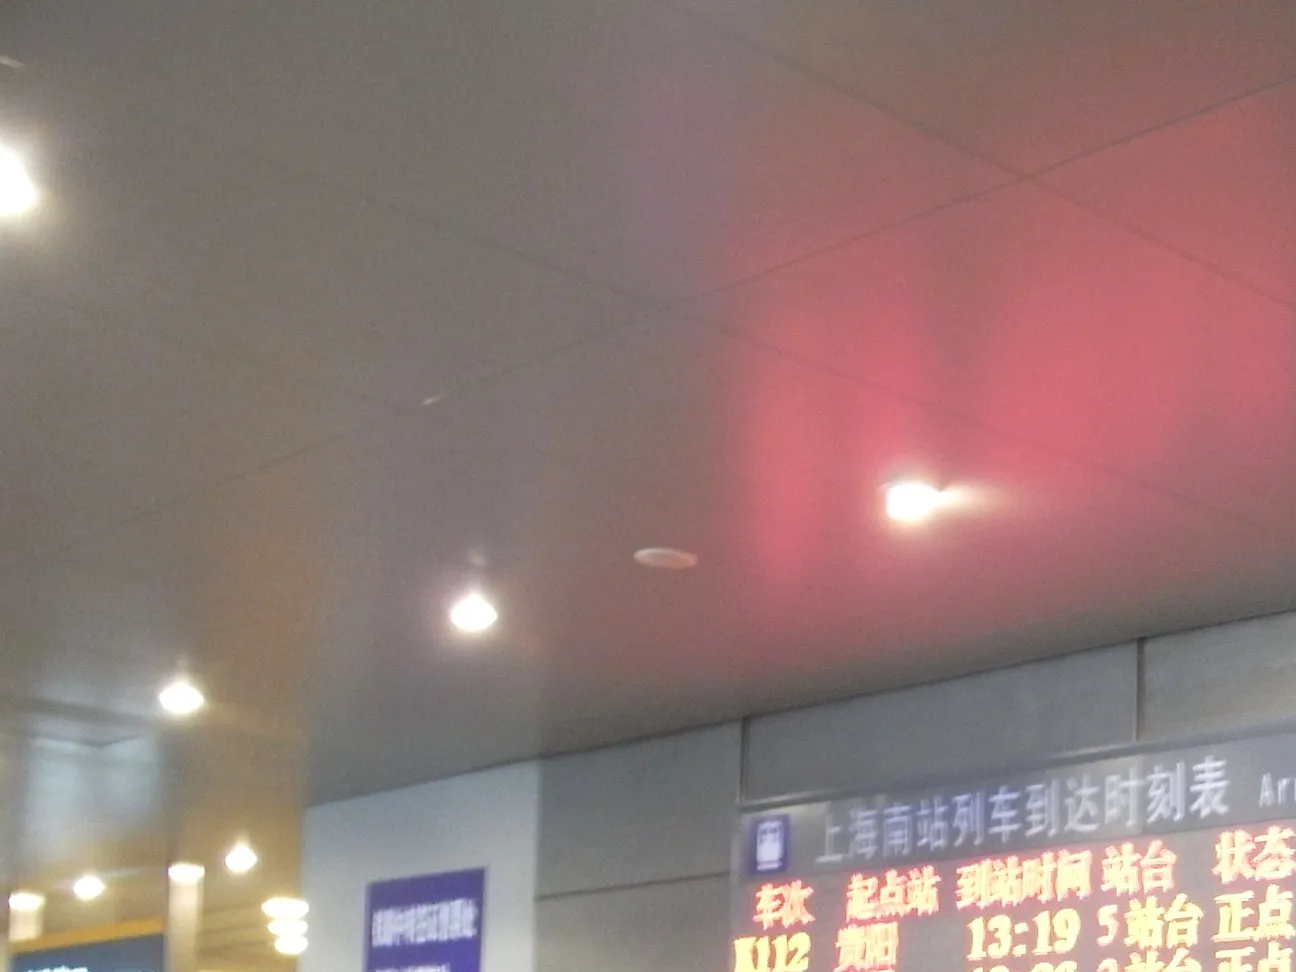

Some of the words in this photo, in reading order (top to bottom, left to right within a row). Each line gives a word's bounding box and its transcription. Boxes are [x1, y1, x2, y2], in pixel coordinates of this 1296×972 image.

[814, 755, 1230, 865] 上海南站列车到达时刻表
[753, 879, 815, 930] 车次
[845, 866, 941, 922] 起点站
[955, 848, 1093, 910] 到站时间
[1101, 840, 1177, 895] 站台
[966, 907, 1081, 961] 13:19
[1211, 884, 1296, 944] 正点
